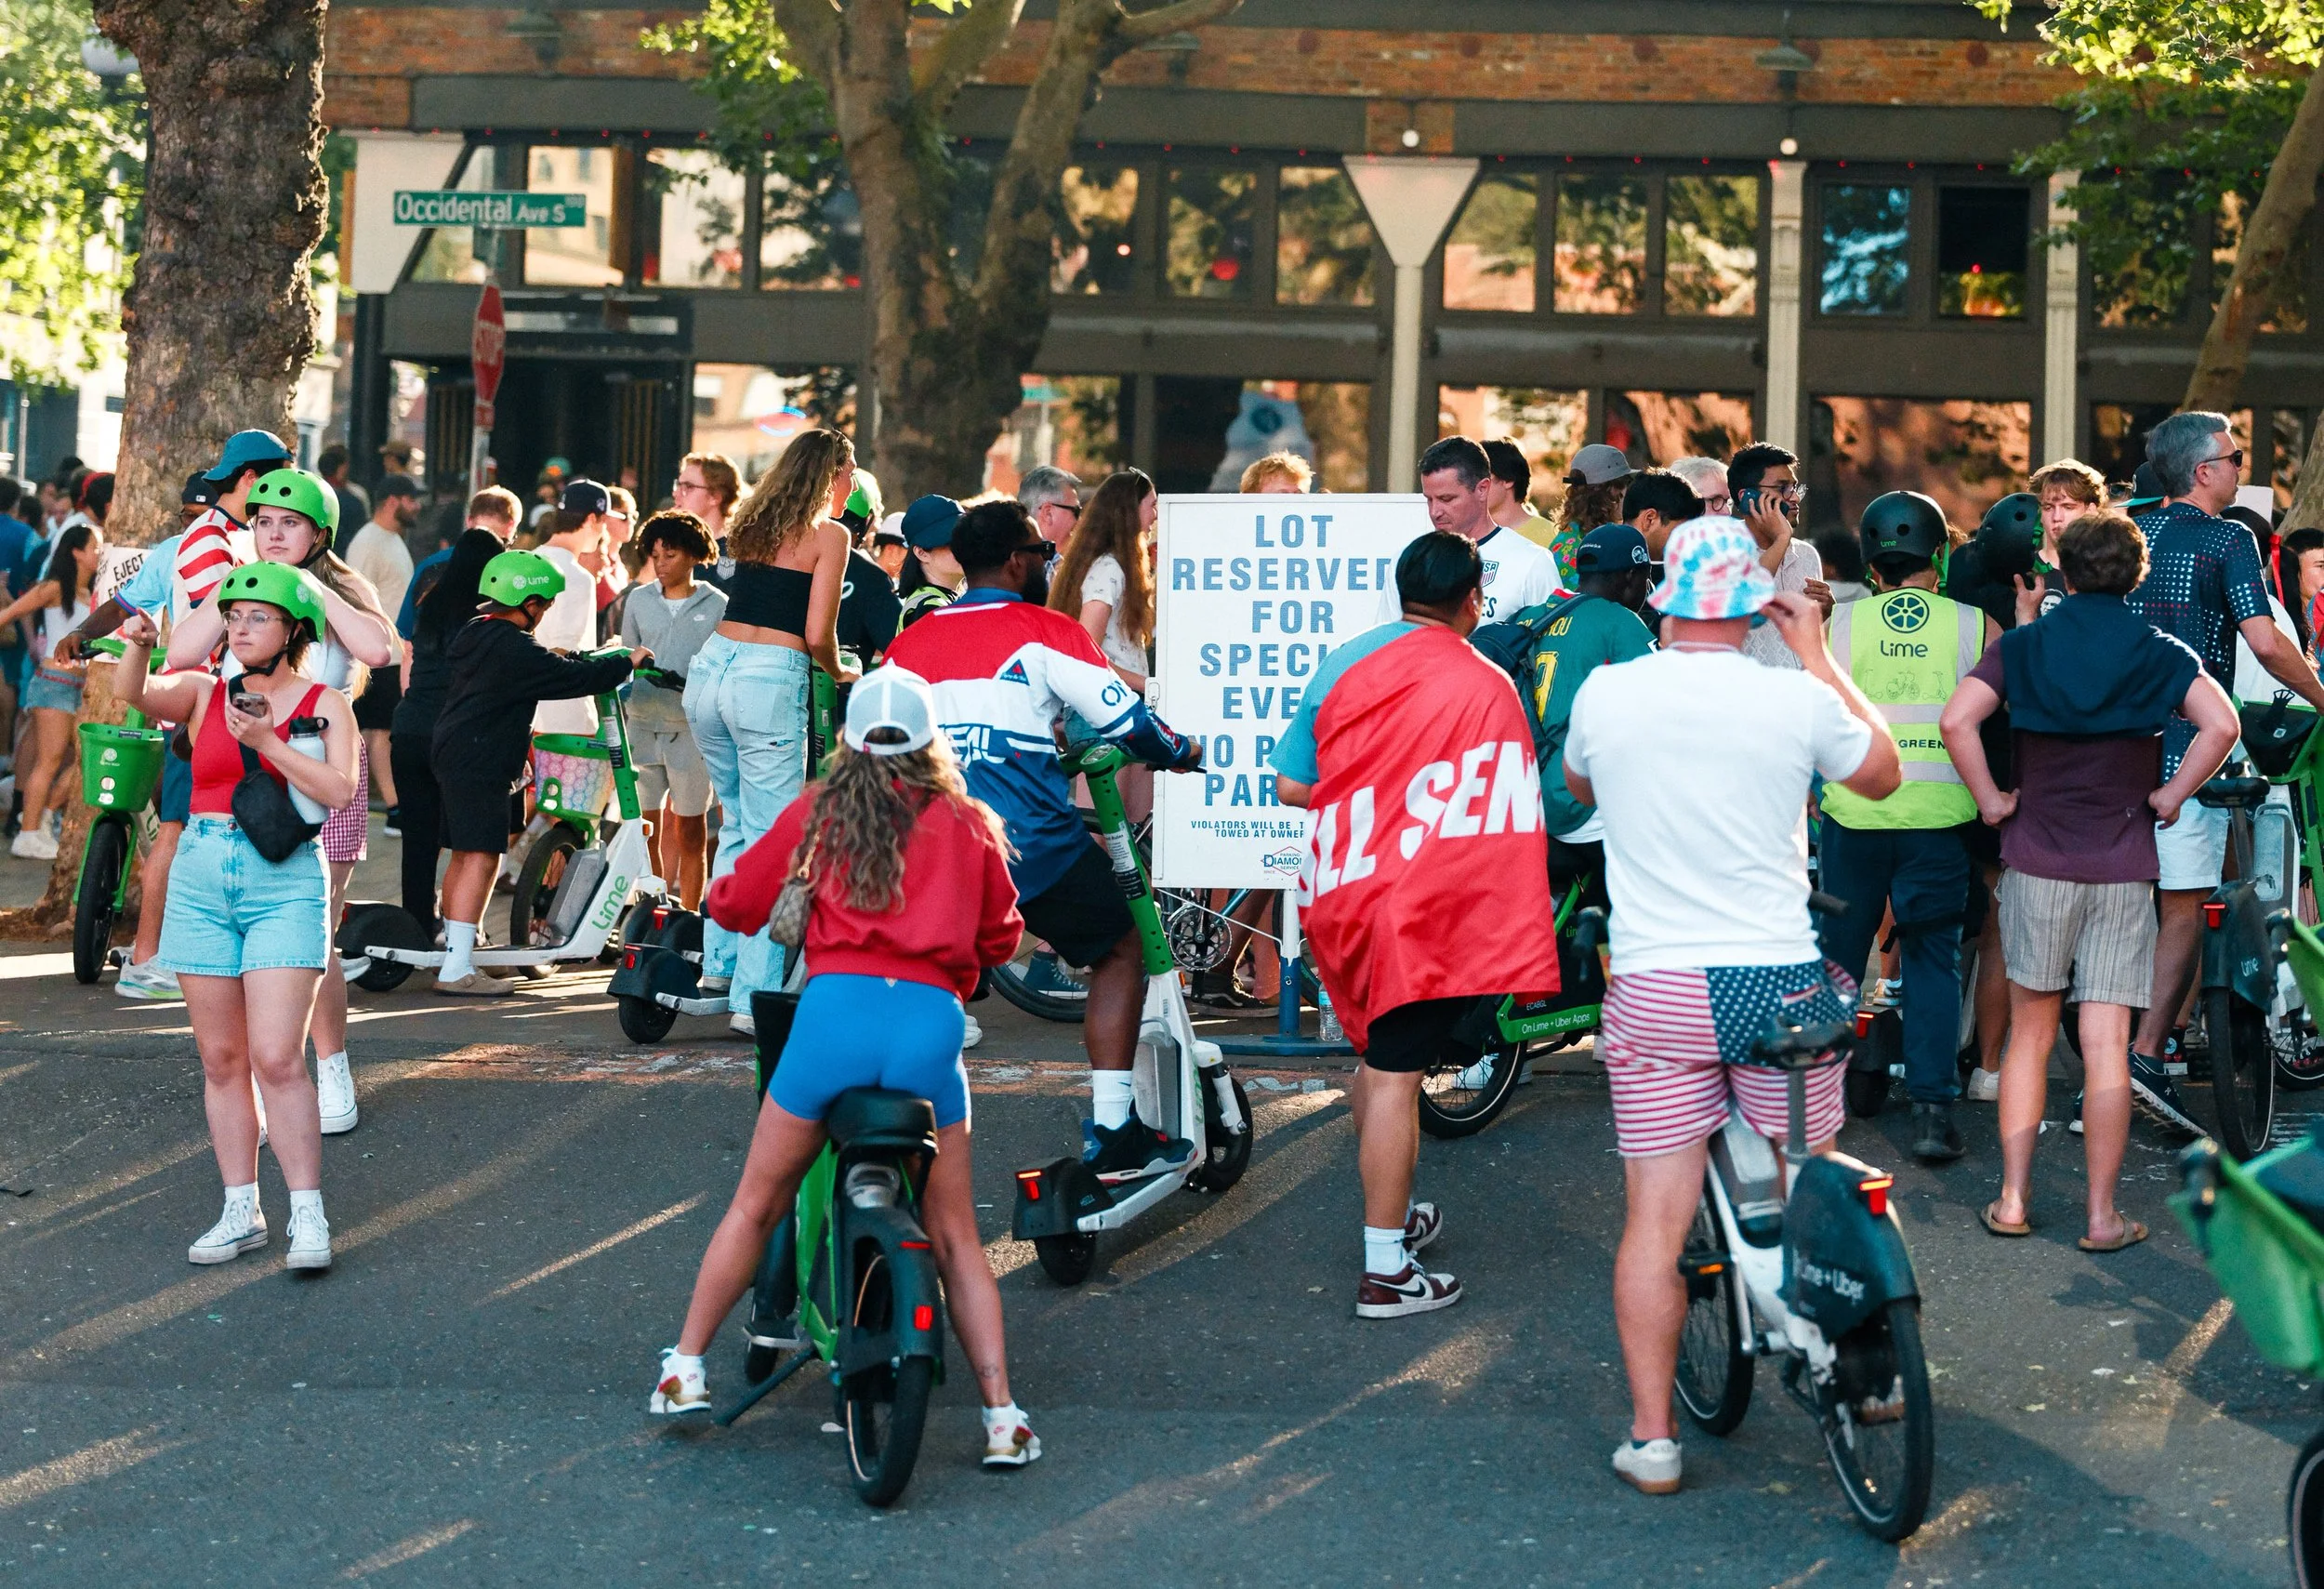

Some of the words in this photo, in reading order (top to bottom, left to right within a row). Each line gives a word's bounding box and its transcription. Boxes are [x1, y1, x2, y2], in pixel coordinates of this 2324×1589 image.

[396, 193, 512, 222] Occidental
[517, 202, 548, 222] Ave
[551, 203, 566, 223] S
[1255, 514, 1333, 549] LOT
[1880, 539, 1897, 548] Lime
[112, 553, 144, 582] EJECT
[527, 576, 550, 586] Lime
[1251, 599, 1335, 634] FOR
[1199, 642, 1327, 677] SPECI
[1880, 640, 1929, 658] Lime
[1221, 686, 1302, 720] EVE
[1399, 740, 1546, 862] SEN
[1191, 820, 1247, 829] VIOLATORS
[1250, 820, 1274, 829] WILL
[1278, 821, 1291, 829] BE
[1215, 828, 1249, 838] TOWED
[1253, 829, 1266, 838] AT
[1263, 854, 1302, 867] DIAMO
[591, 875, 628, 930] Lime
[1522, 1024, 1532, 1034] On
[1532, 1022, 1549, 1032] Lime
[1554, 1017, 1572, 1027] Uber
[1572, 1013, 1591, 1024] Apps
